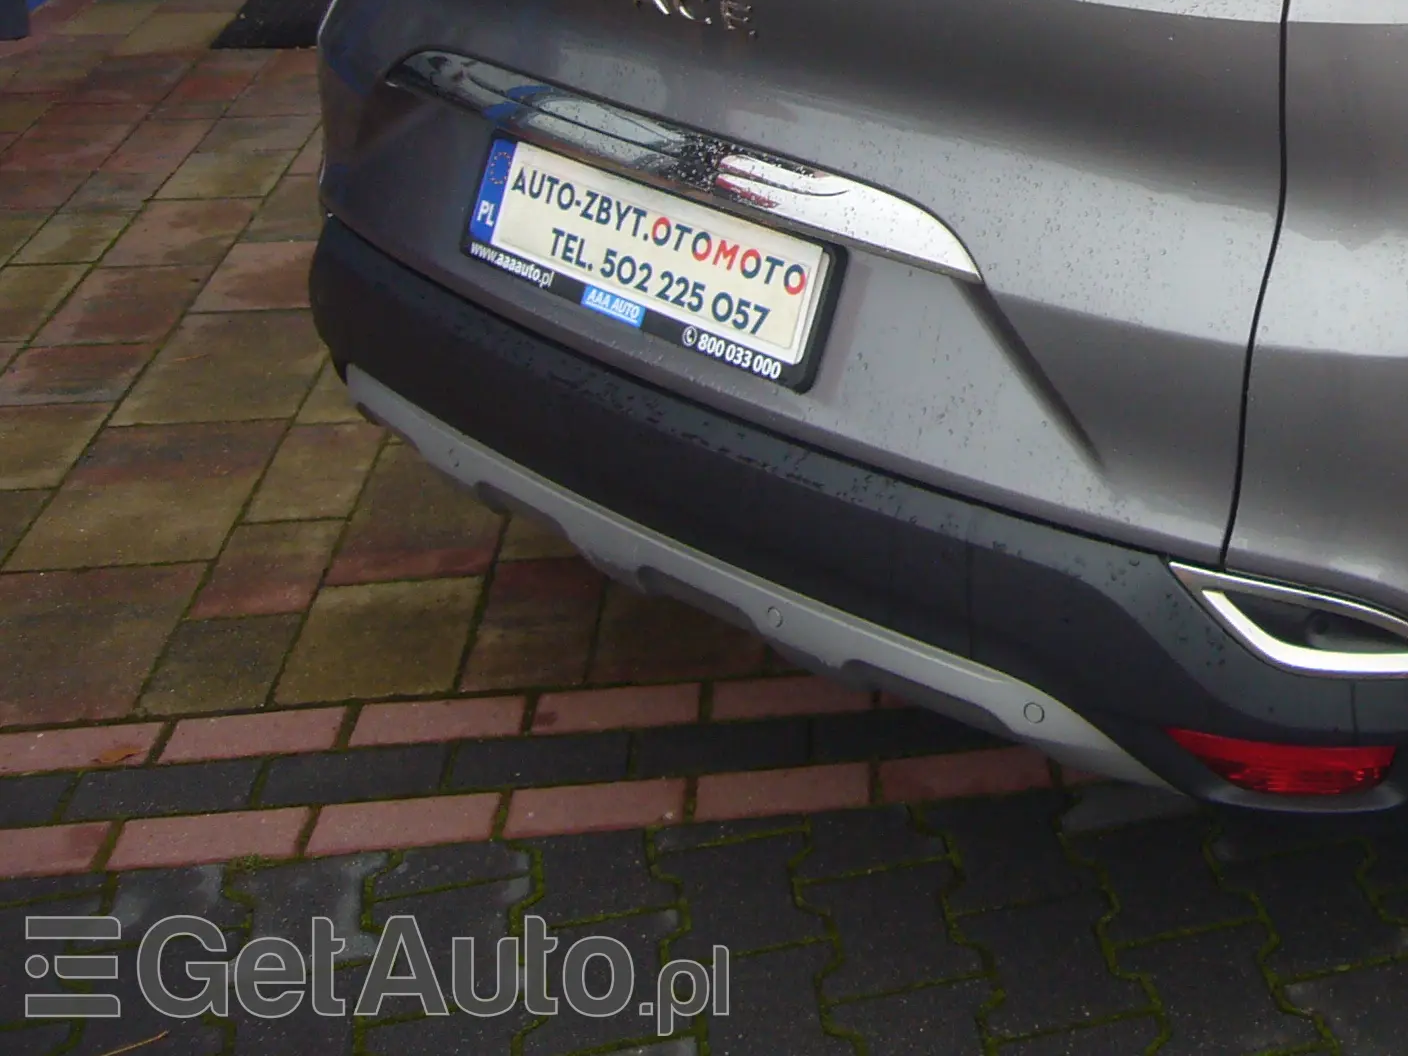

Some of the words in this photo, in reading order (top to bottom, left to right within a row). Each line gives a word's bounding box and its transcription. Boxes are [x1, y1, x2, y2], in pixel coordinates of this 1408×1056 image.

[476, 199, 495, 228] PL
[511, 166, 806, 296] AUTO-ZBYT.OTOMOTO
[470, 241, 555, 288] www.aaaauto.pl
[551, 228, 593, 272] TEL.
[600, 248, 653, 293] 502
[655, 270, 704, 313] 225
[712, 291, 770, 336] 057
[585, 288, 611, 309] AAA
[612, 297, 641, 321] AUTO
[698, 333, 724, 359] 800
[725, 342, 750, 370] 033
[753, 351, 781, 380] 000
